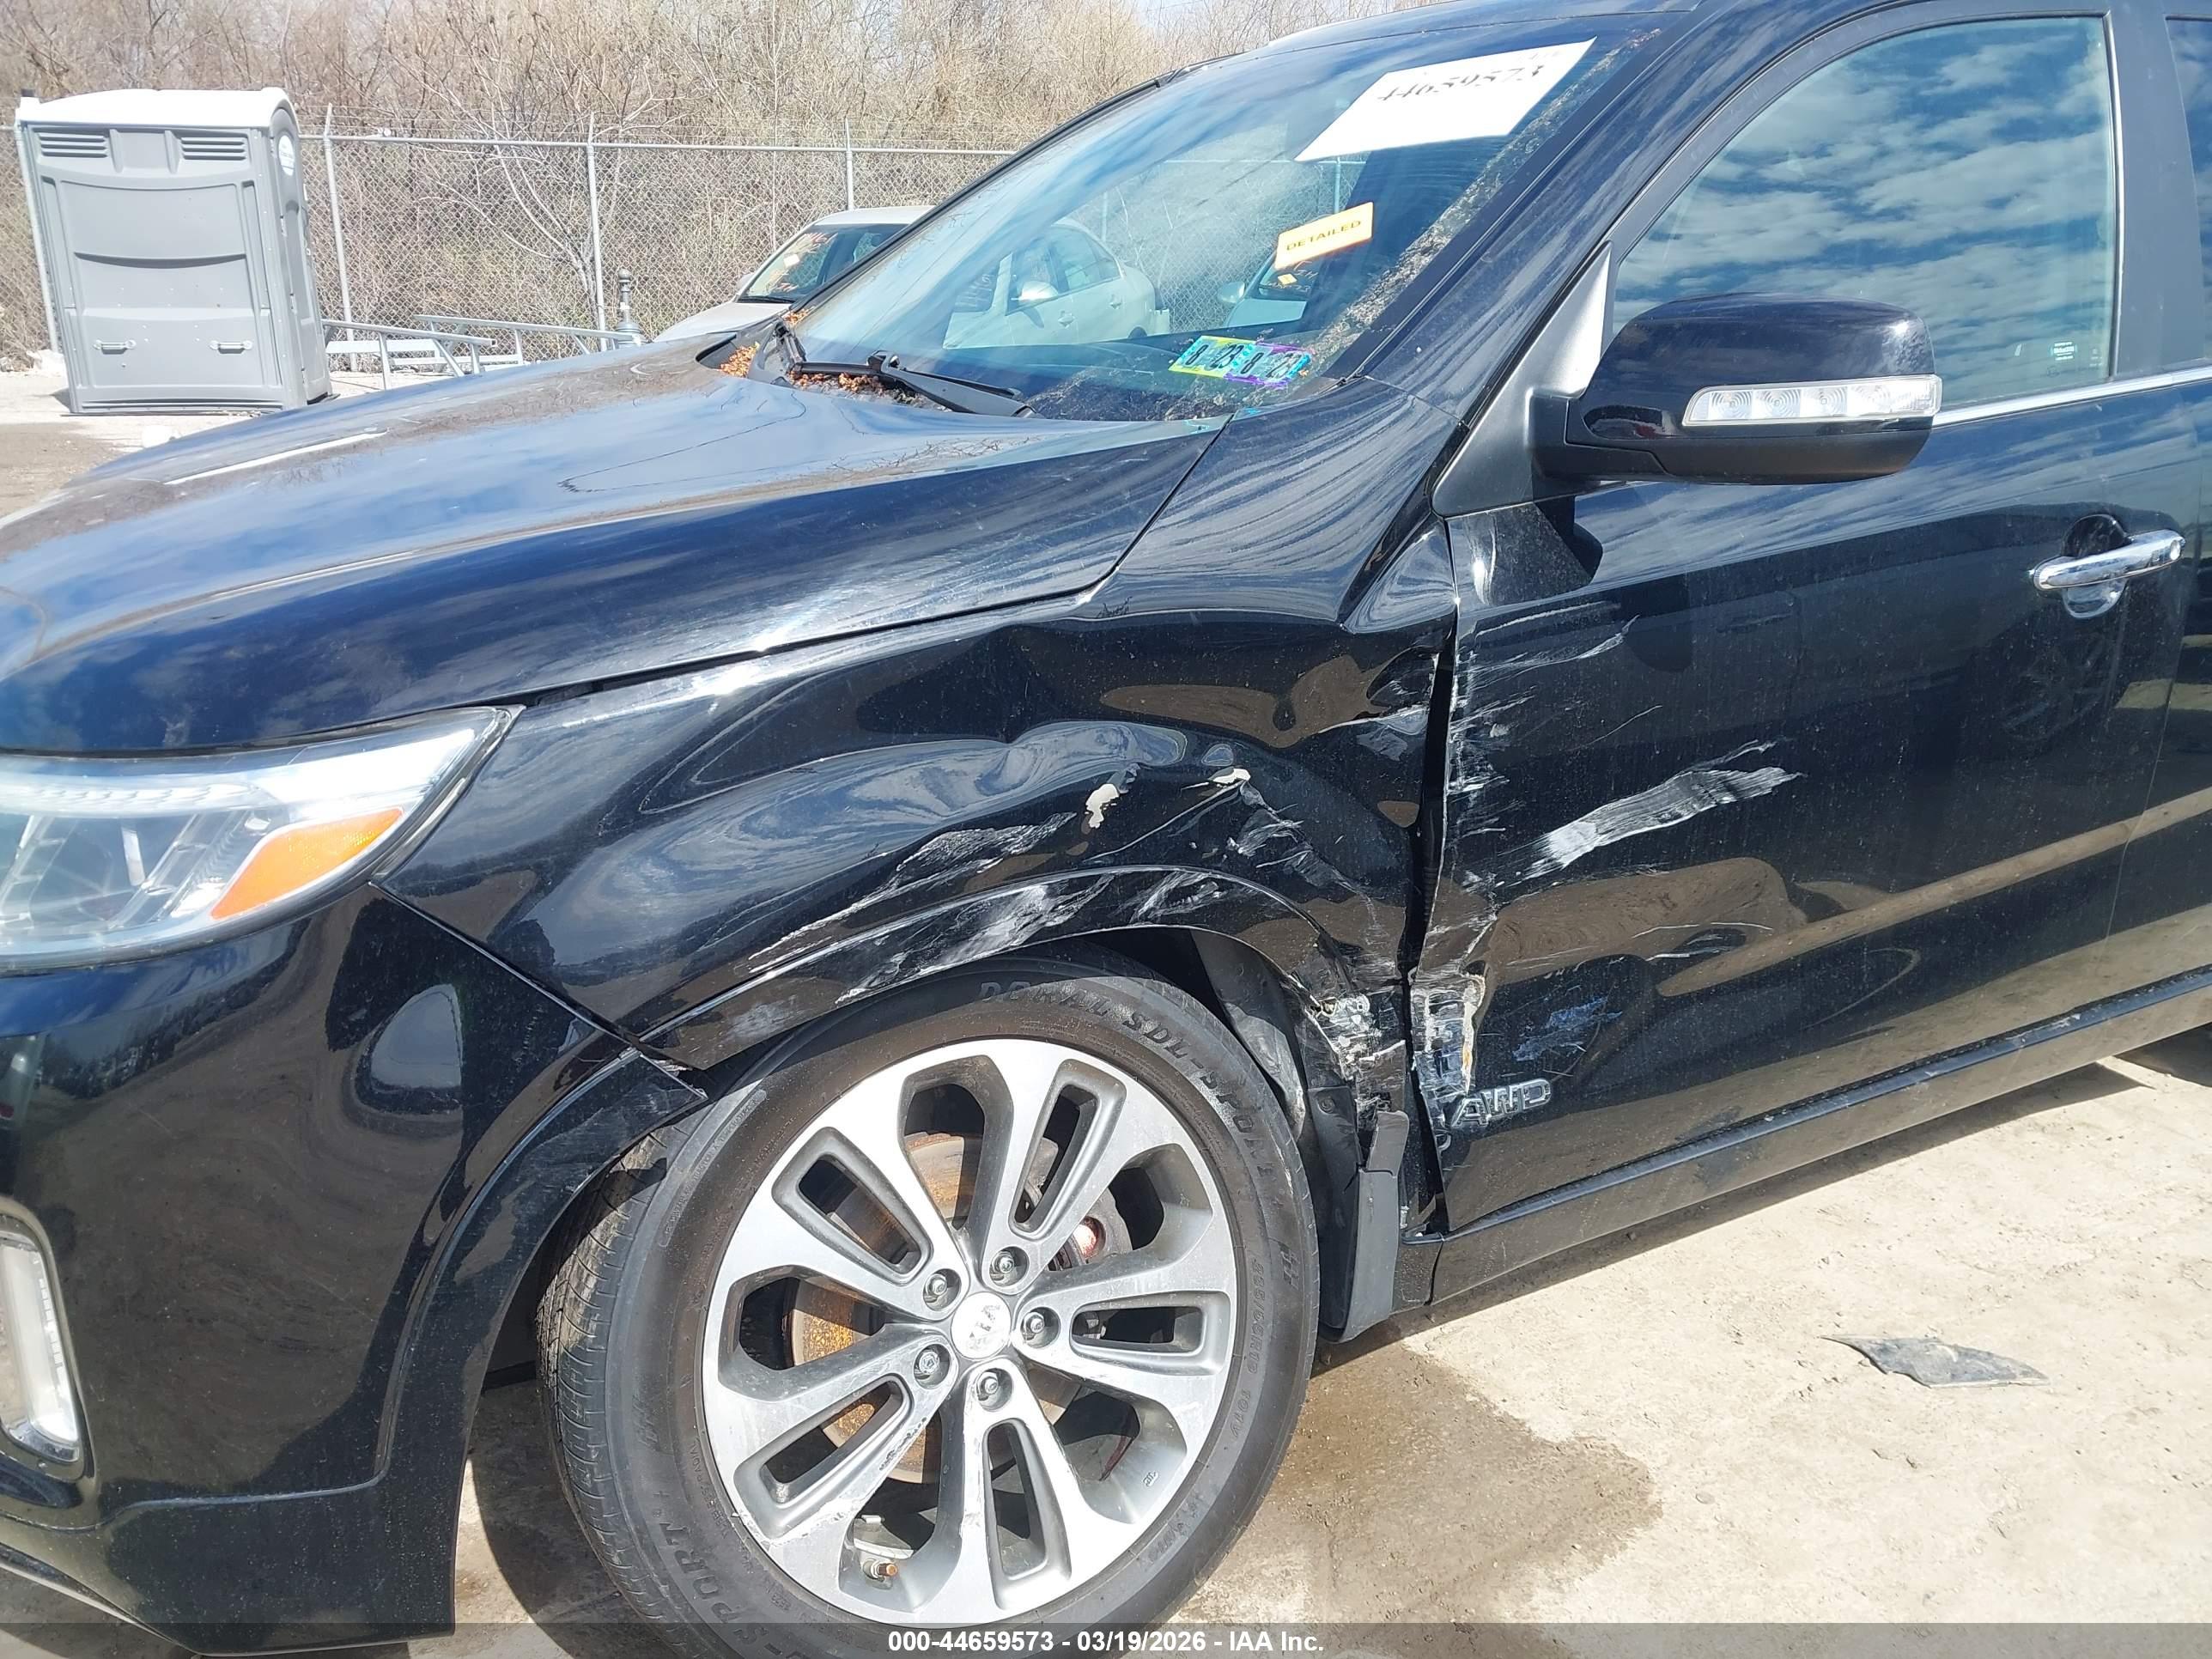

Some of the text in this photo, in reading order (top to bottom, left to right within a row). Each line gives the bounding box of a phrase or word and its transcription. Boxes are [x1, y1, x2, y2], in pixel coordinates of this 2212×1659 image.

[1286, 220, 1362, 251] DETAILED
[1185, 344, 1209, 365] 8
[1210, 344, 1244, 368] 23
[1241, 352, 1264, 374] 8
[659, 1522, 810, 1659] -SPORT
